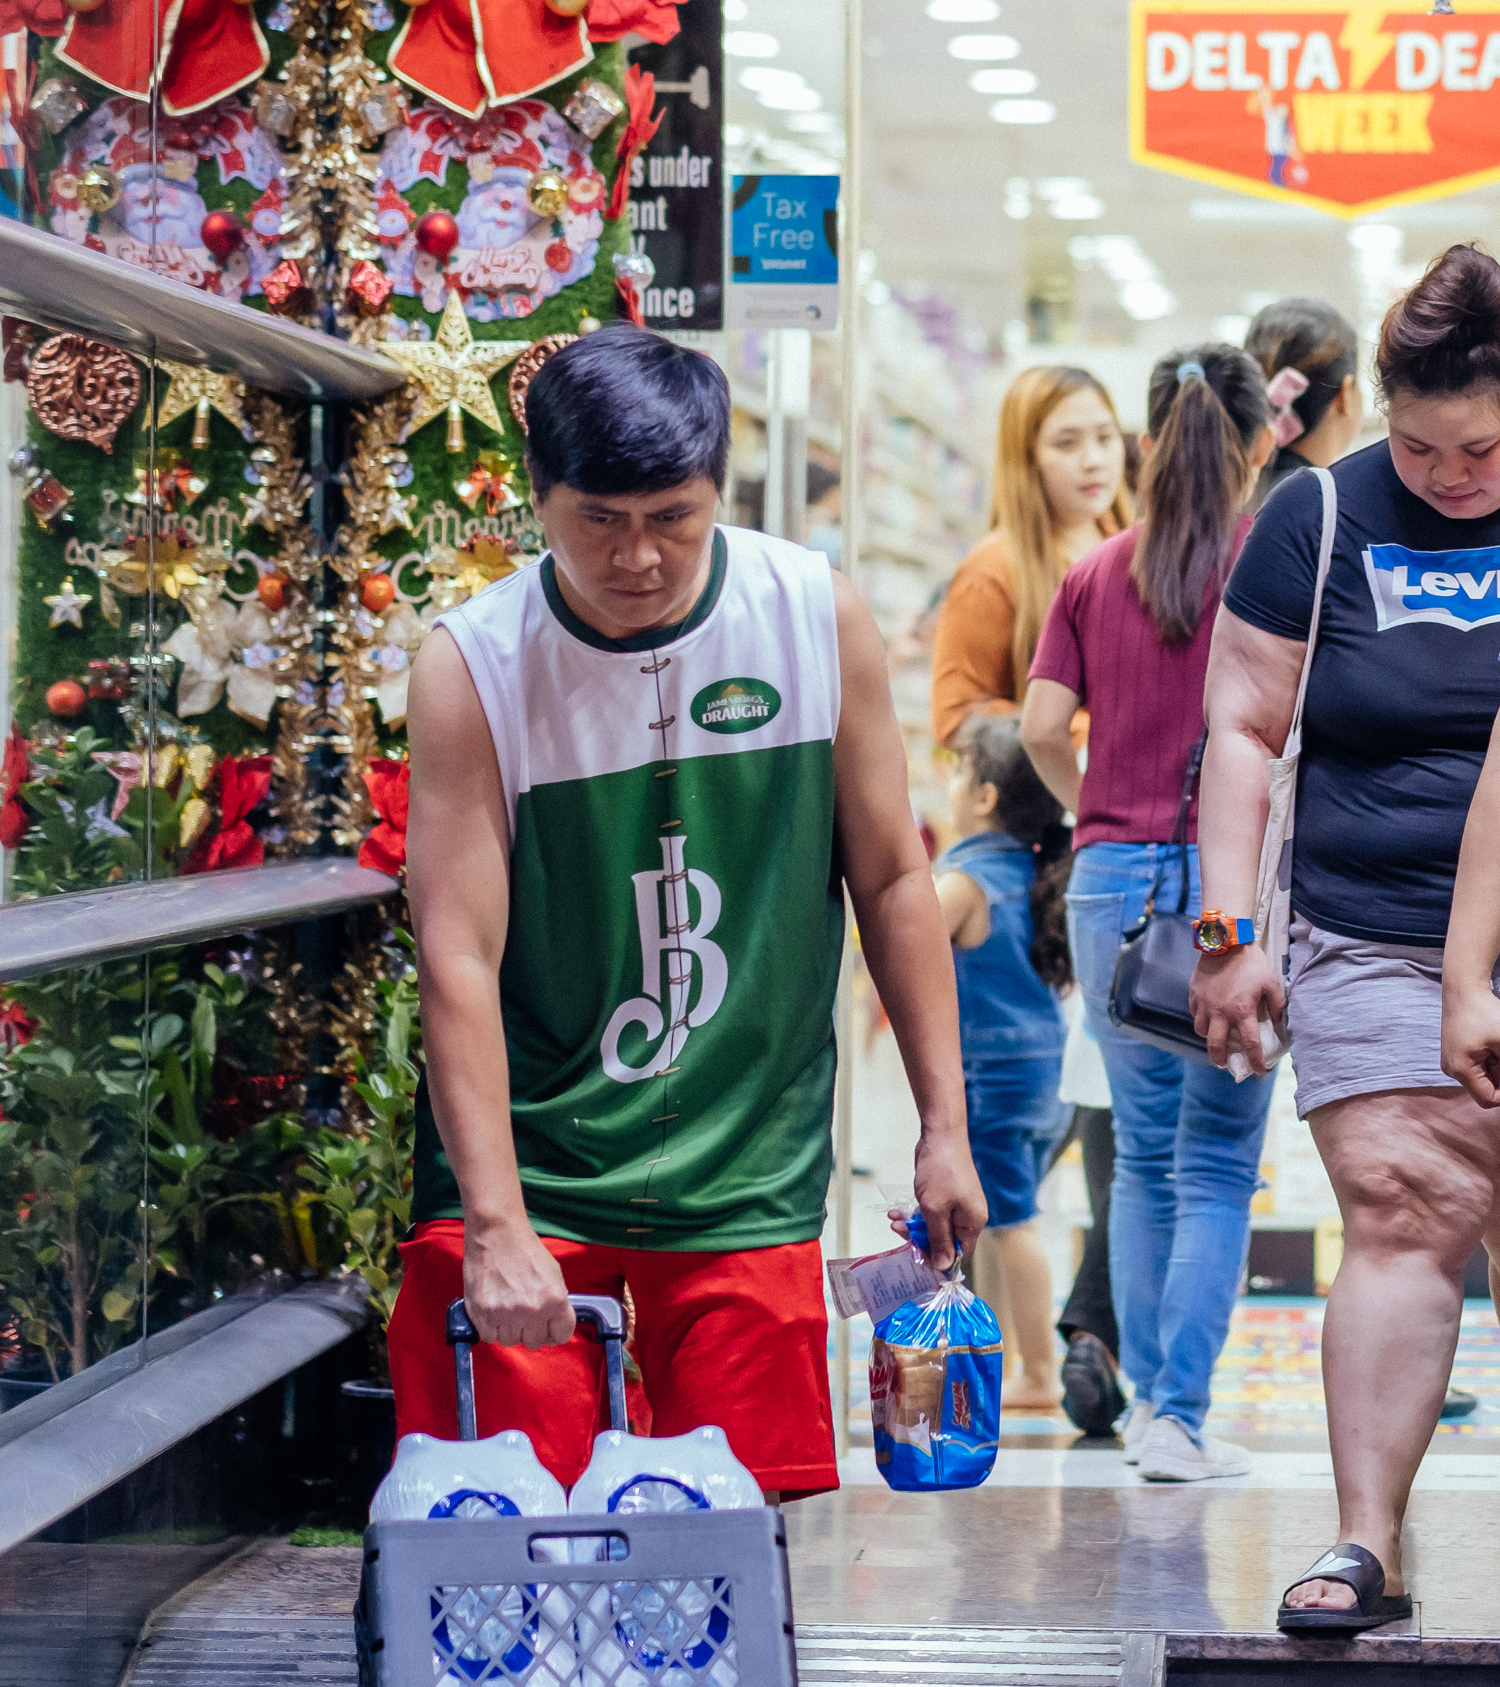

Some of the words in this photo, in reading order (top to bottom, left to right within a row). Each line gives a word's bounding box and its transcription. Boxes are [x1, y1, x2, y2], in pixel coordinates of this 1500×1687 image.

[1146, 31, 1341, 91] DELTA
[1293, 92, 1434, 153] WEEK
[650, 145, 712, 188] under
[762, 192, 807, 220] Tax
[753, 222, 815, 250] Free
[702, 705, 770, 725] DRAUGHT
